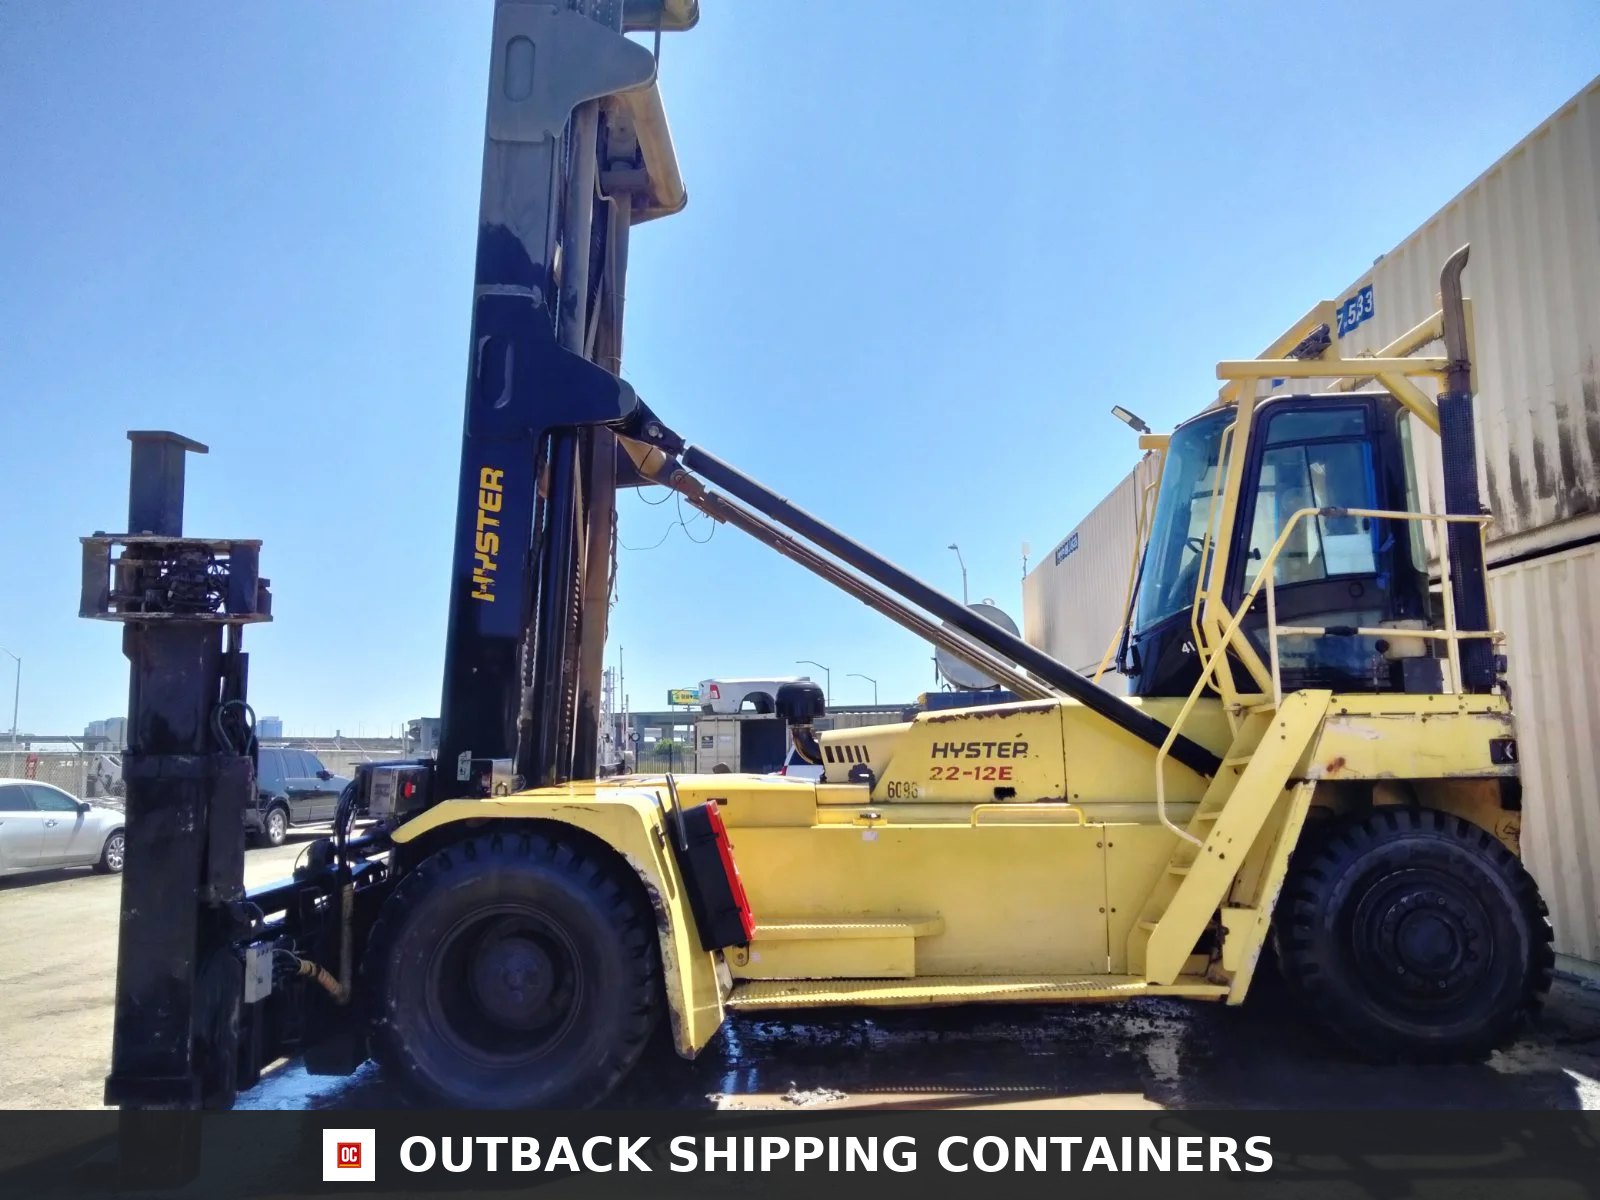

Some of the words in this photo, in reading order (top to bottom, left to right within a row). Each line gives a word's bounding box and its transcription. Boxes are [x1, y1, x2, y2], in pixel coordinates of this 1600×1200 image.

[471, 467, 504, 602] HYSTER
[931, 742, 1029, 759] HYSTER
[929, 766, 1013, 781] 22-12E
